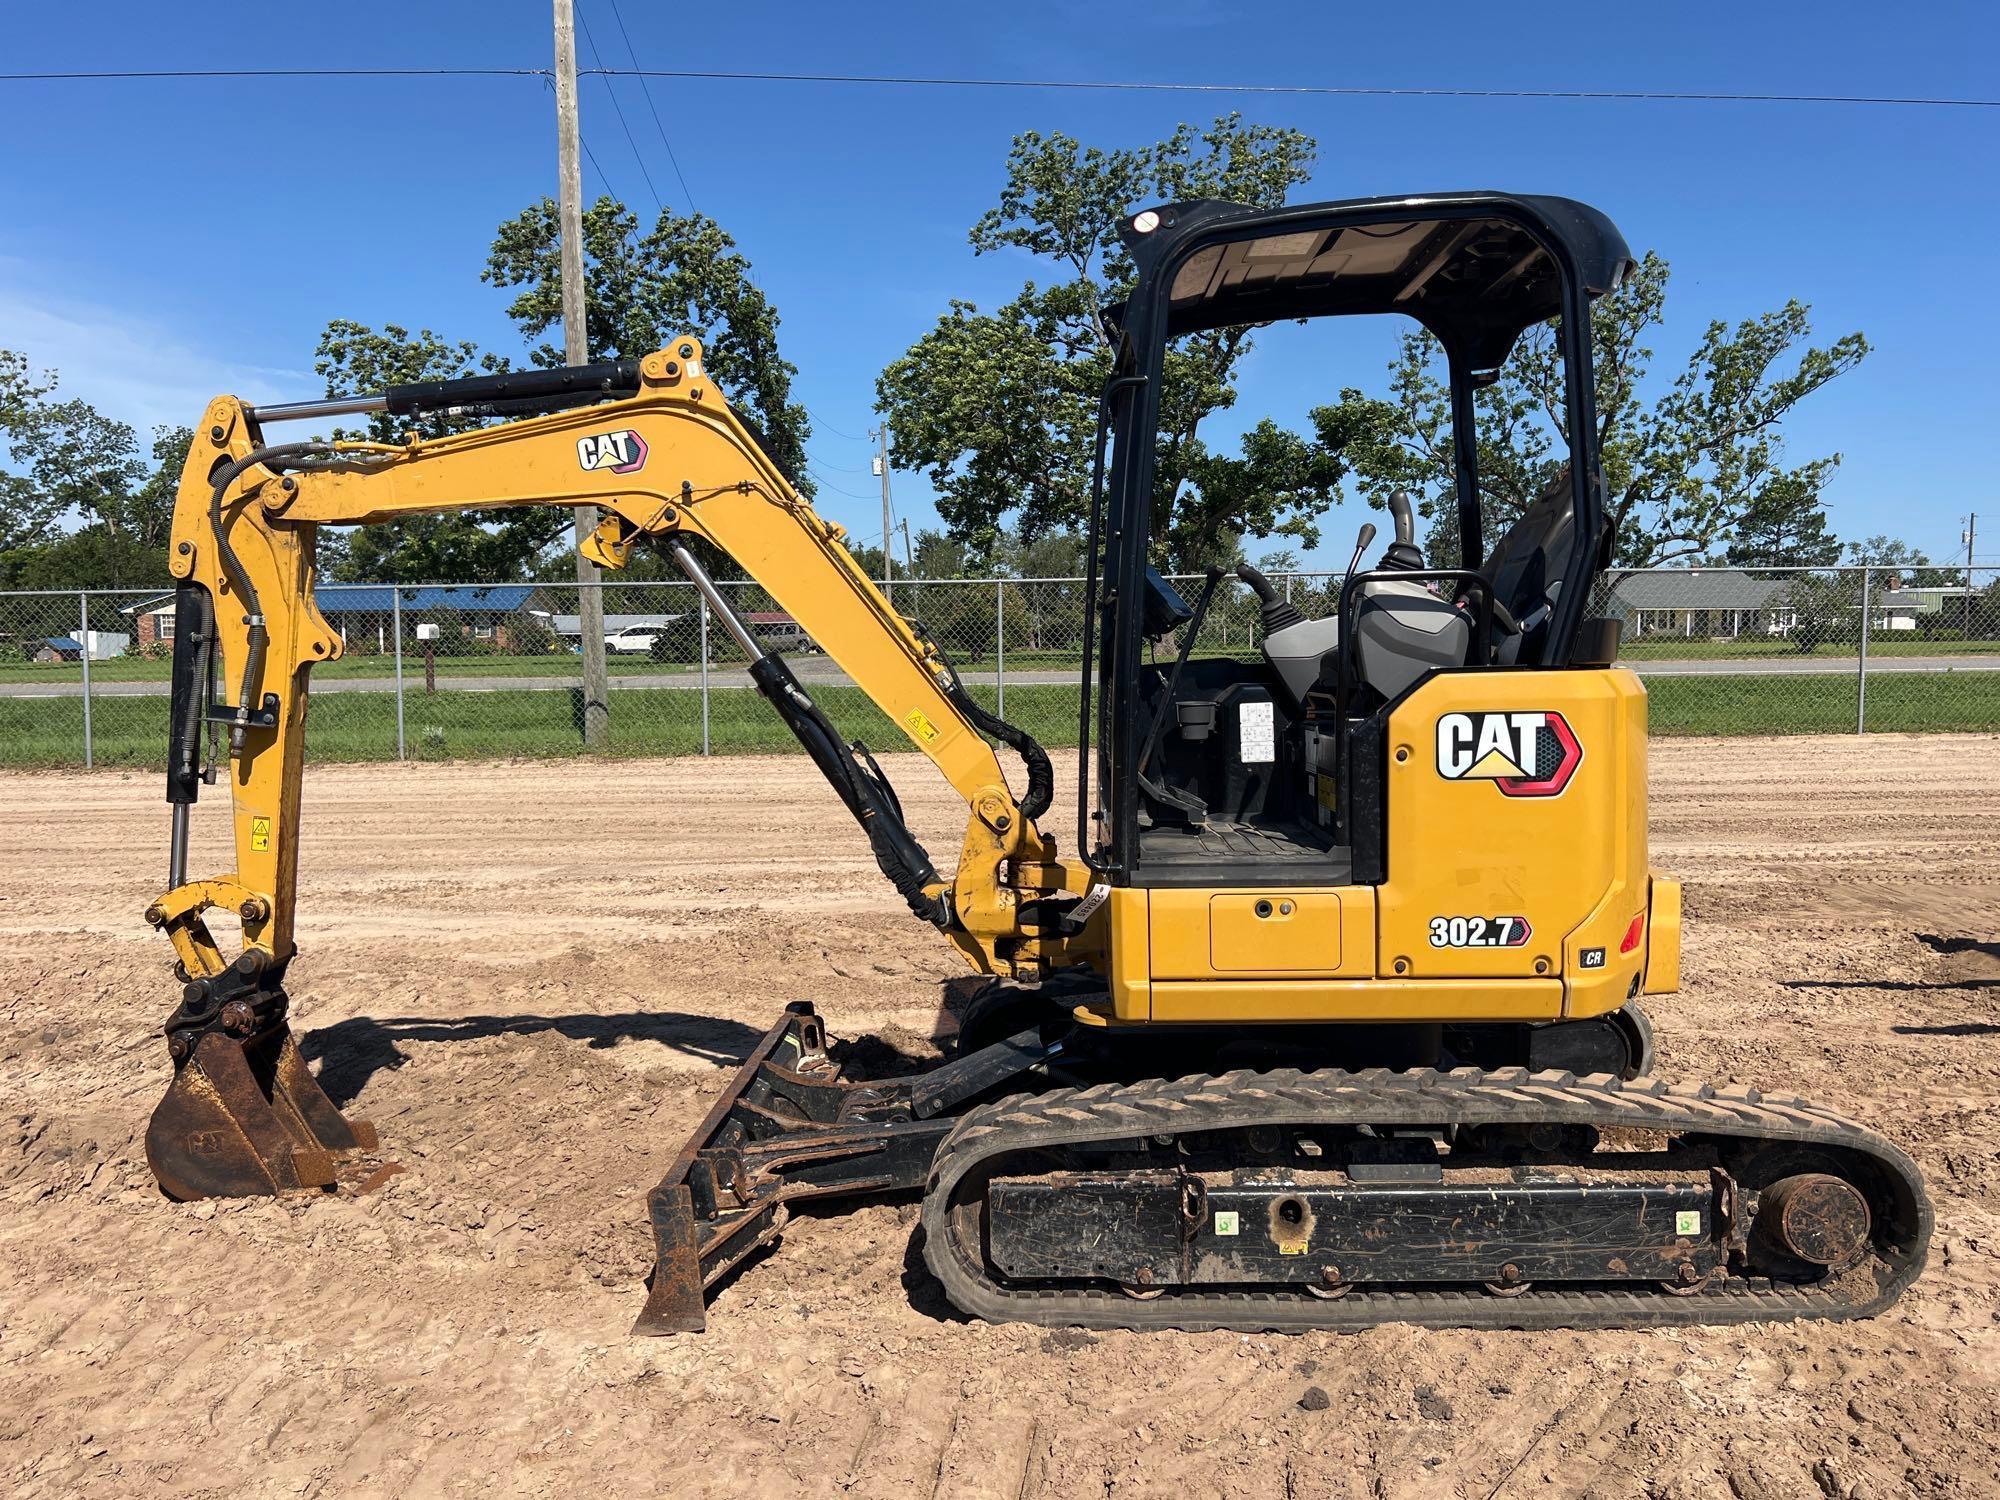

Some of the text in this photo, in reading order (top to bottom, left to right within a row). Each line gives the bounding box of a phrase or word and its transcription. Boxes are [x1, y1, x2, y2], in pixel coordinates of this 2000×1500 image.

[578, 431, 629, 470] CAT
[1438, 712, 1546, 778] CAT
[1077, 894, 1104, 917] 220485
[1430, 917, 1514, 946] 302.7
[1586, 951, 1602, 965] CR
